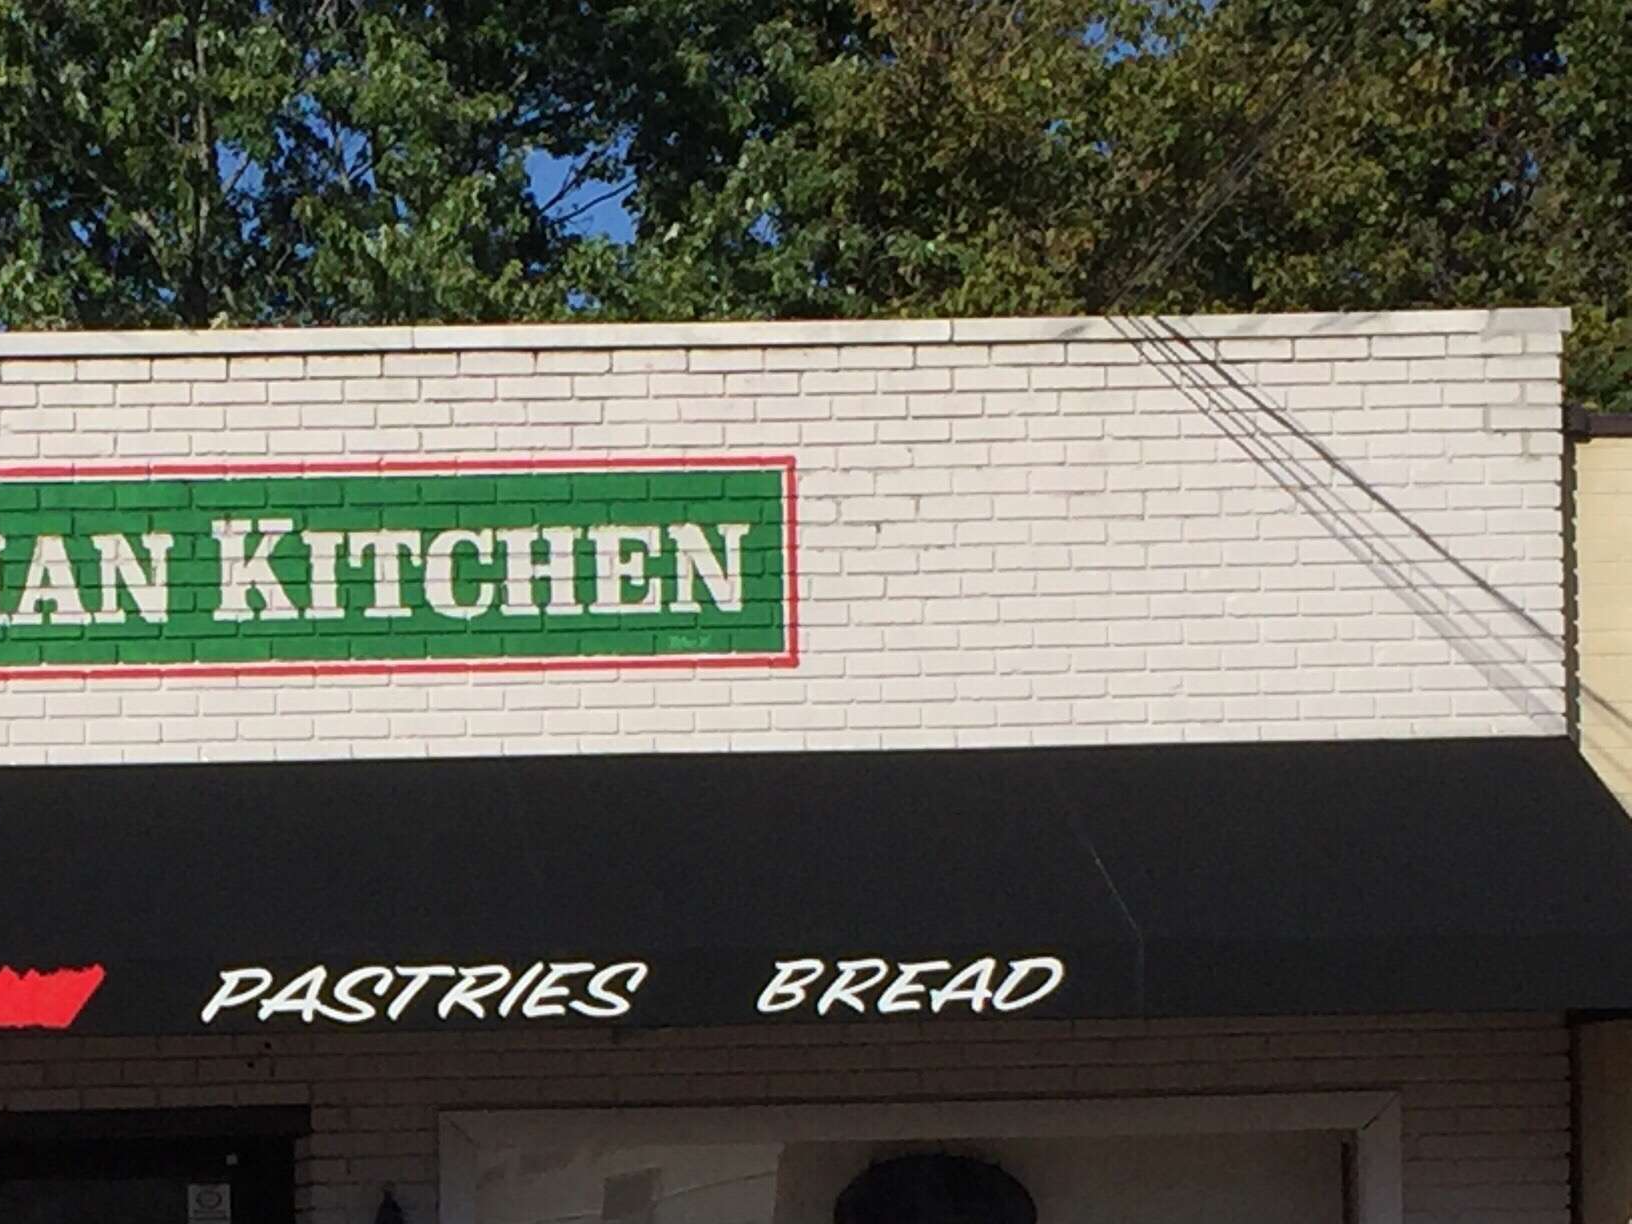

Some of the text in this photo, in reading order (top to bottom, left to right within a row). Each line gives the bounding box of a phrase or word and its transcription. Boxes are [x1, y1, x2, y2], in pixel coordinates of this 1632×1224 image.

[210, 517, 751, 623] KITCHEN
[200, 956, 1067, 1024] PASTRIES BREAD
